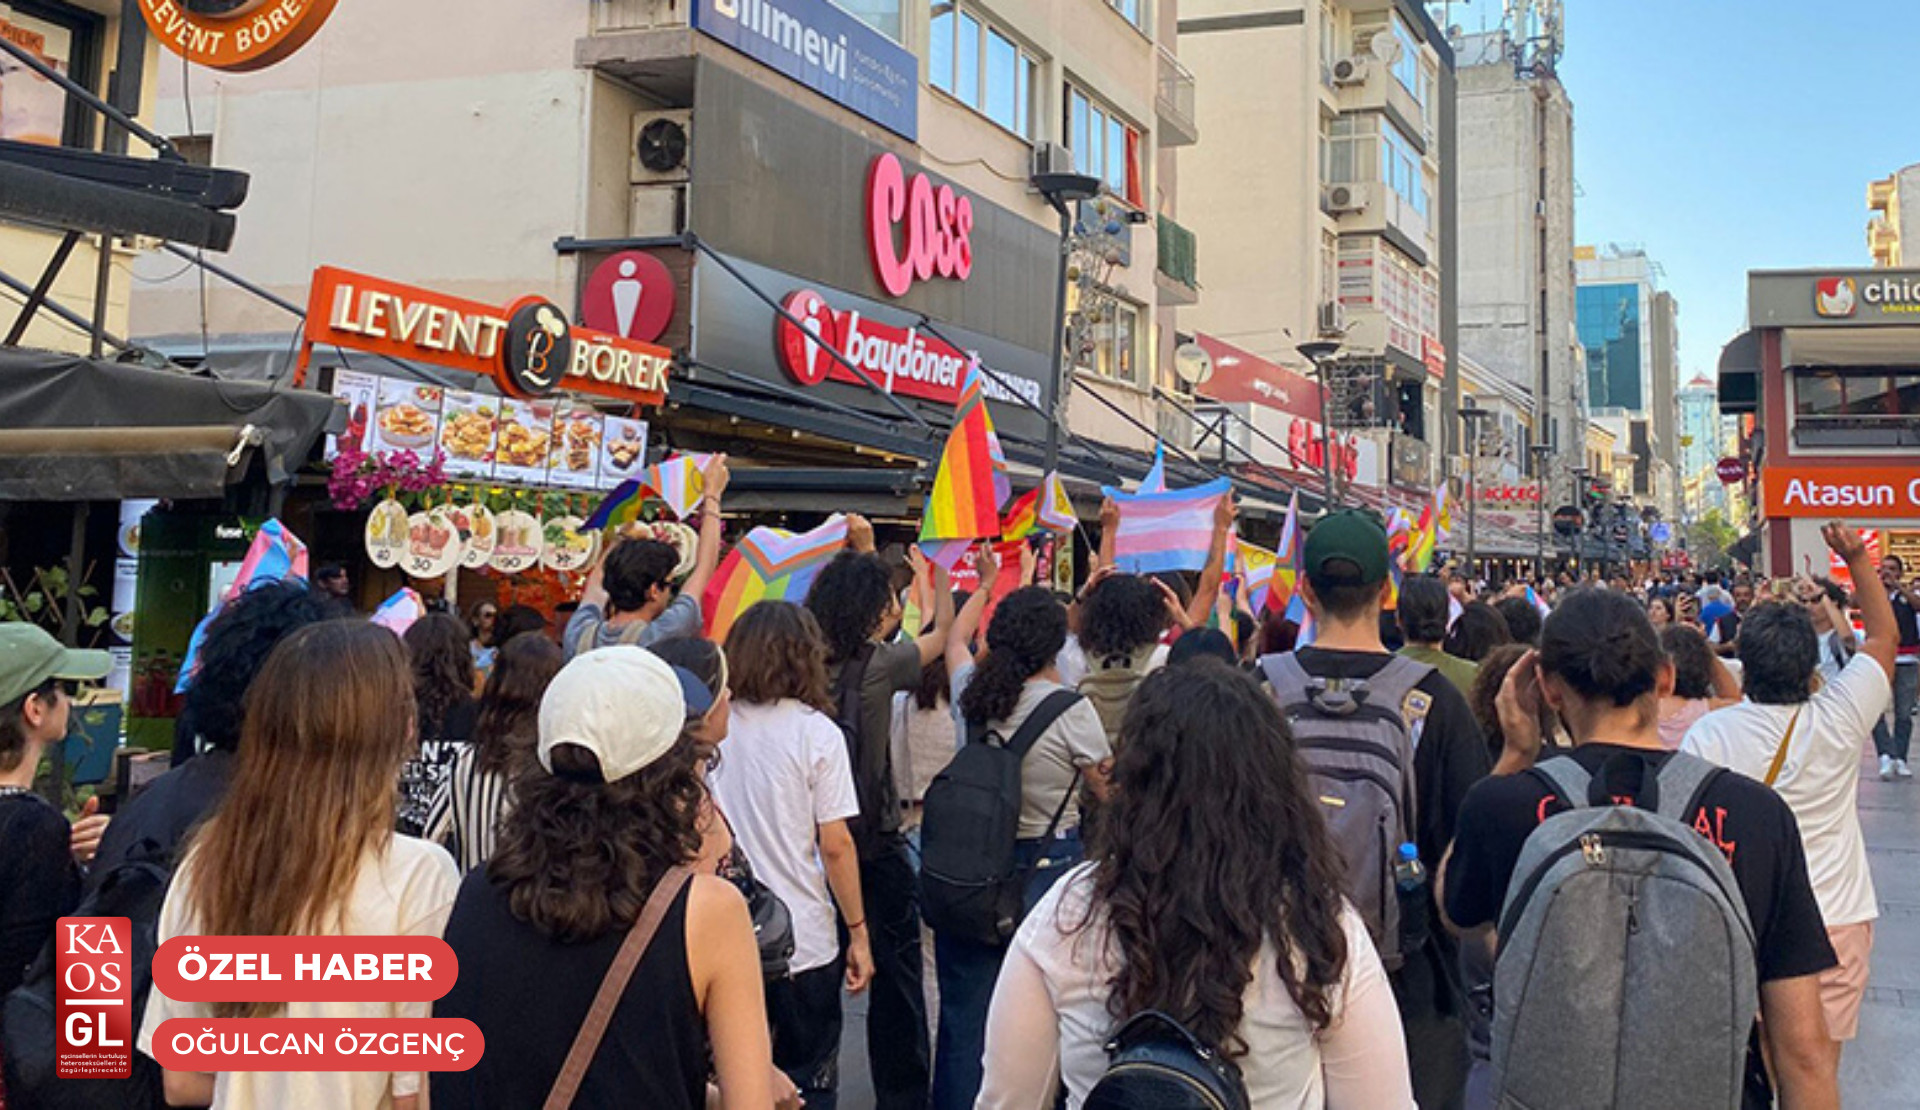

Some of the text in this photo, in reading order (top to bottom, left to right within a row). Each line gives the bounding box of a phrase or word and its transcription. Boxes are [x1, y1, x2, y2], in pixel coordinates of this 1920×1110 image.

[147, 0, 224, 55] EVENT
[329, 284, 508, 358] LEVENT
[571, 339, 671, 394] BÖREK
[846, 310, 963, 393] baydöner
[1784, 478, 1895, 506] Atasun
